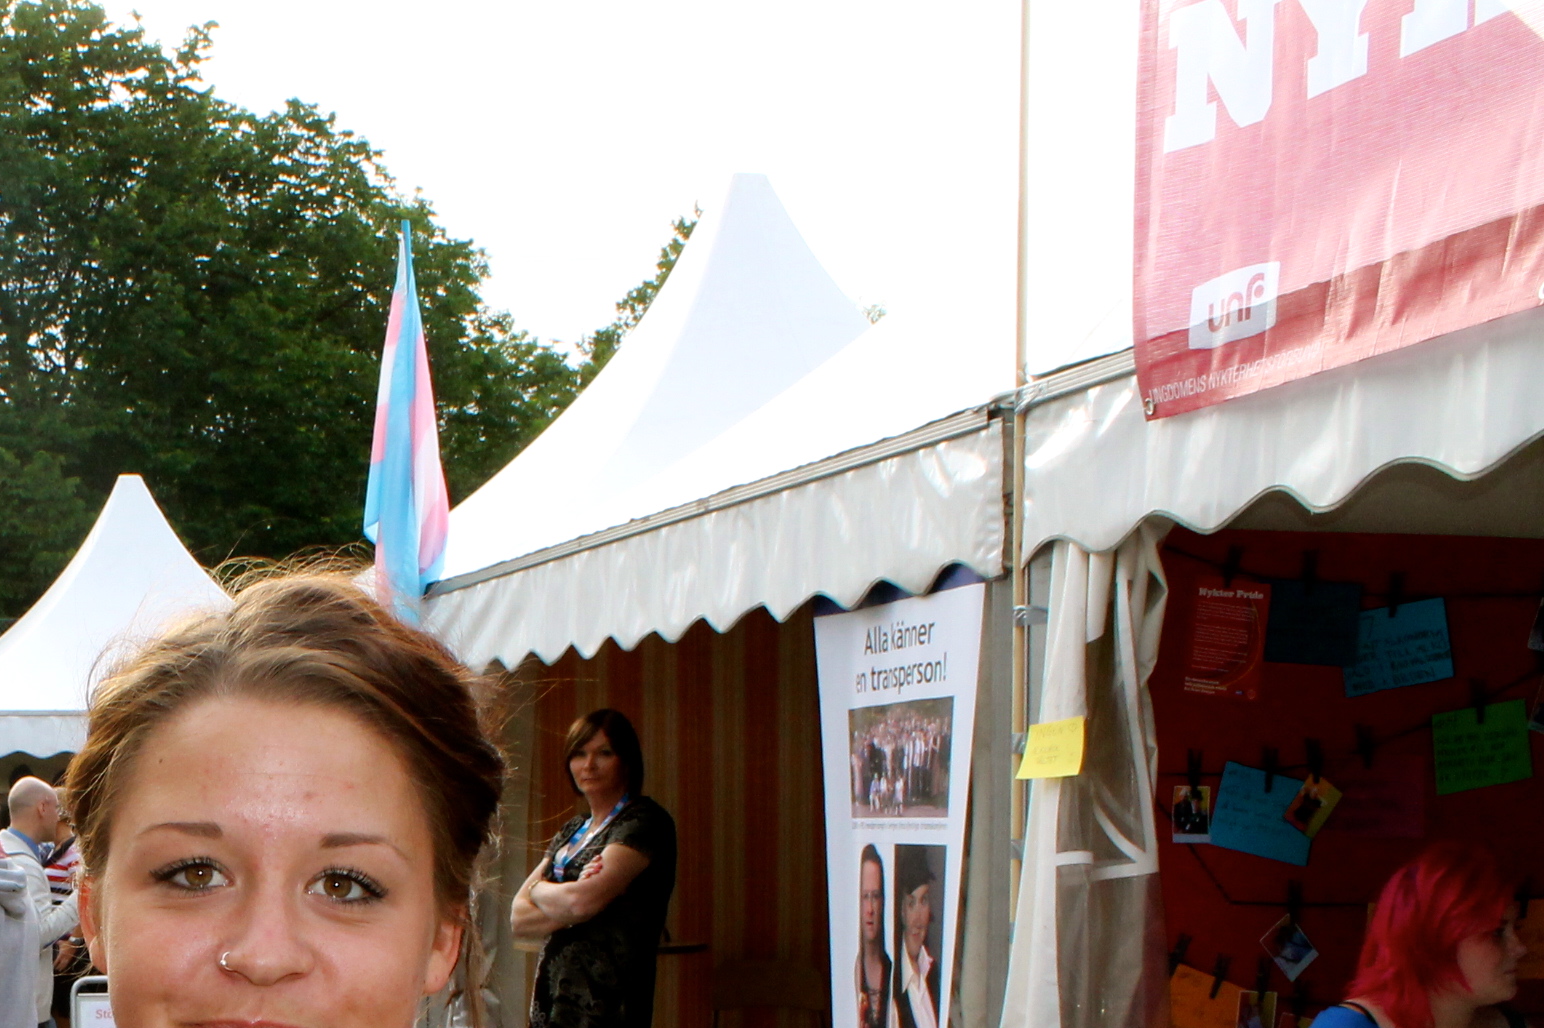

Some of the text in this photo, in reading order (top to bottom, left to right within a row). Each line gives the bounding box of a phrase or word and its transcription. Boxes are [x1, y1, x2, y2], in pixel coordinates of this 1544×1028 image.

[1149, 374, 1207, 405] UNGDOMENS
[1198, 587, 1264, 600] Nykter Pride
[864, 620, 935, 655] Alla känner
[856, 652, 947, 695] en transperson!
